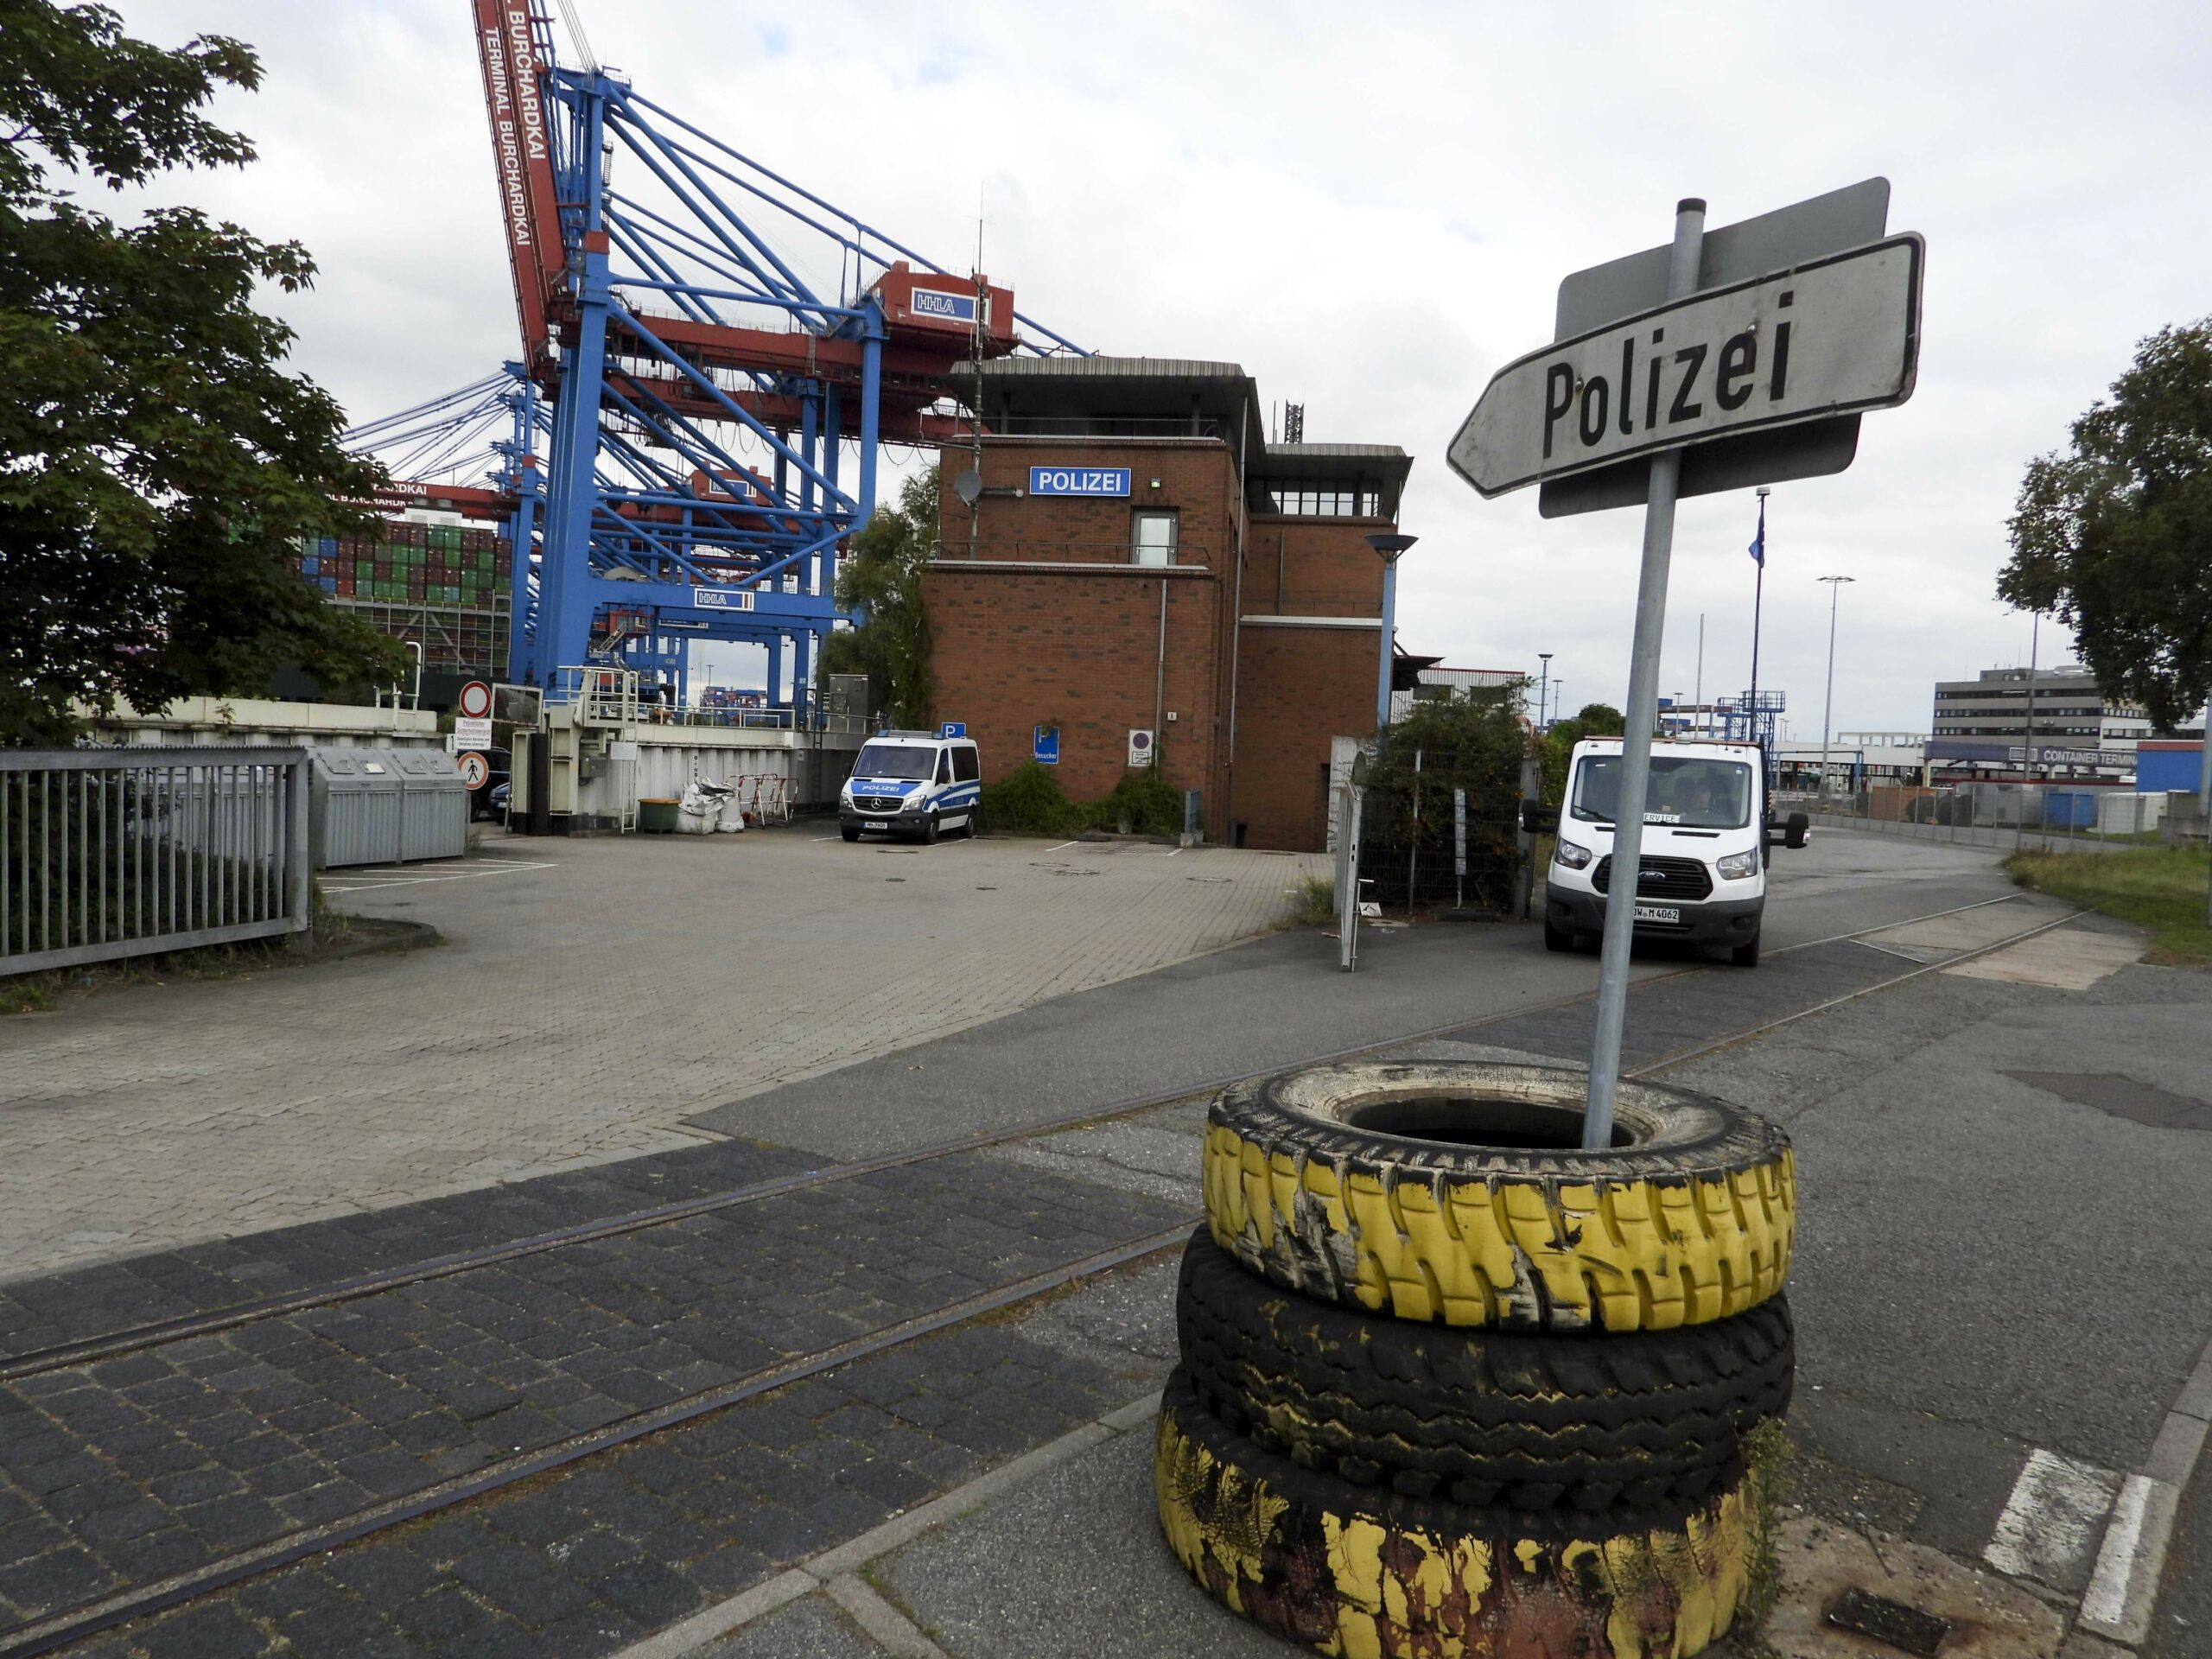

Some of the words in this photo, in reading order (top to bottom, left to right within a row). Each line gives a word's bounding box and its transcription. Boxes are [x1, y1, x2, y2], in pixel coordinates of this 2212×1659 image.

[509, 10, 545, 160] BURCHARDKAI
[485, 26, 508, 116] TERMINAL
[499, 120, 531, 246] BURCHARDKAI
[918, 295, 955, 314] HHLA
[1542, 290, 1794, 460] Polizei
[1039, 473, 1122, 491] POLIZEI
[698, 593, 728, 605] HHLA
[2044, 750, 2099, 764] CONTAINER
[1656, 910, 1678, 920] 4062
